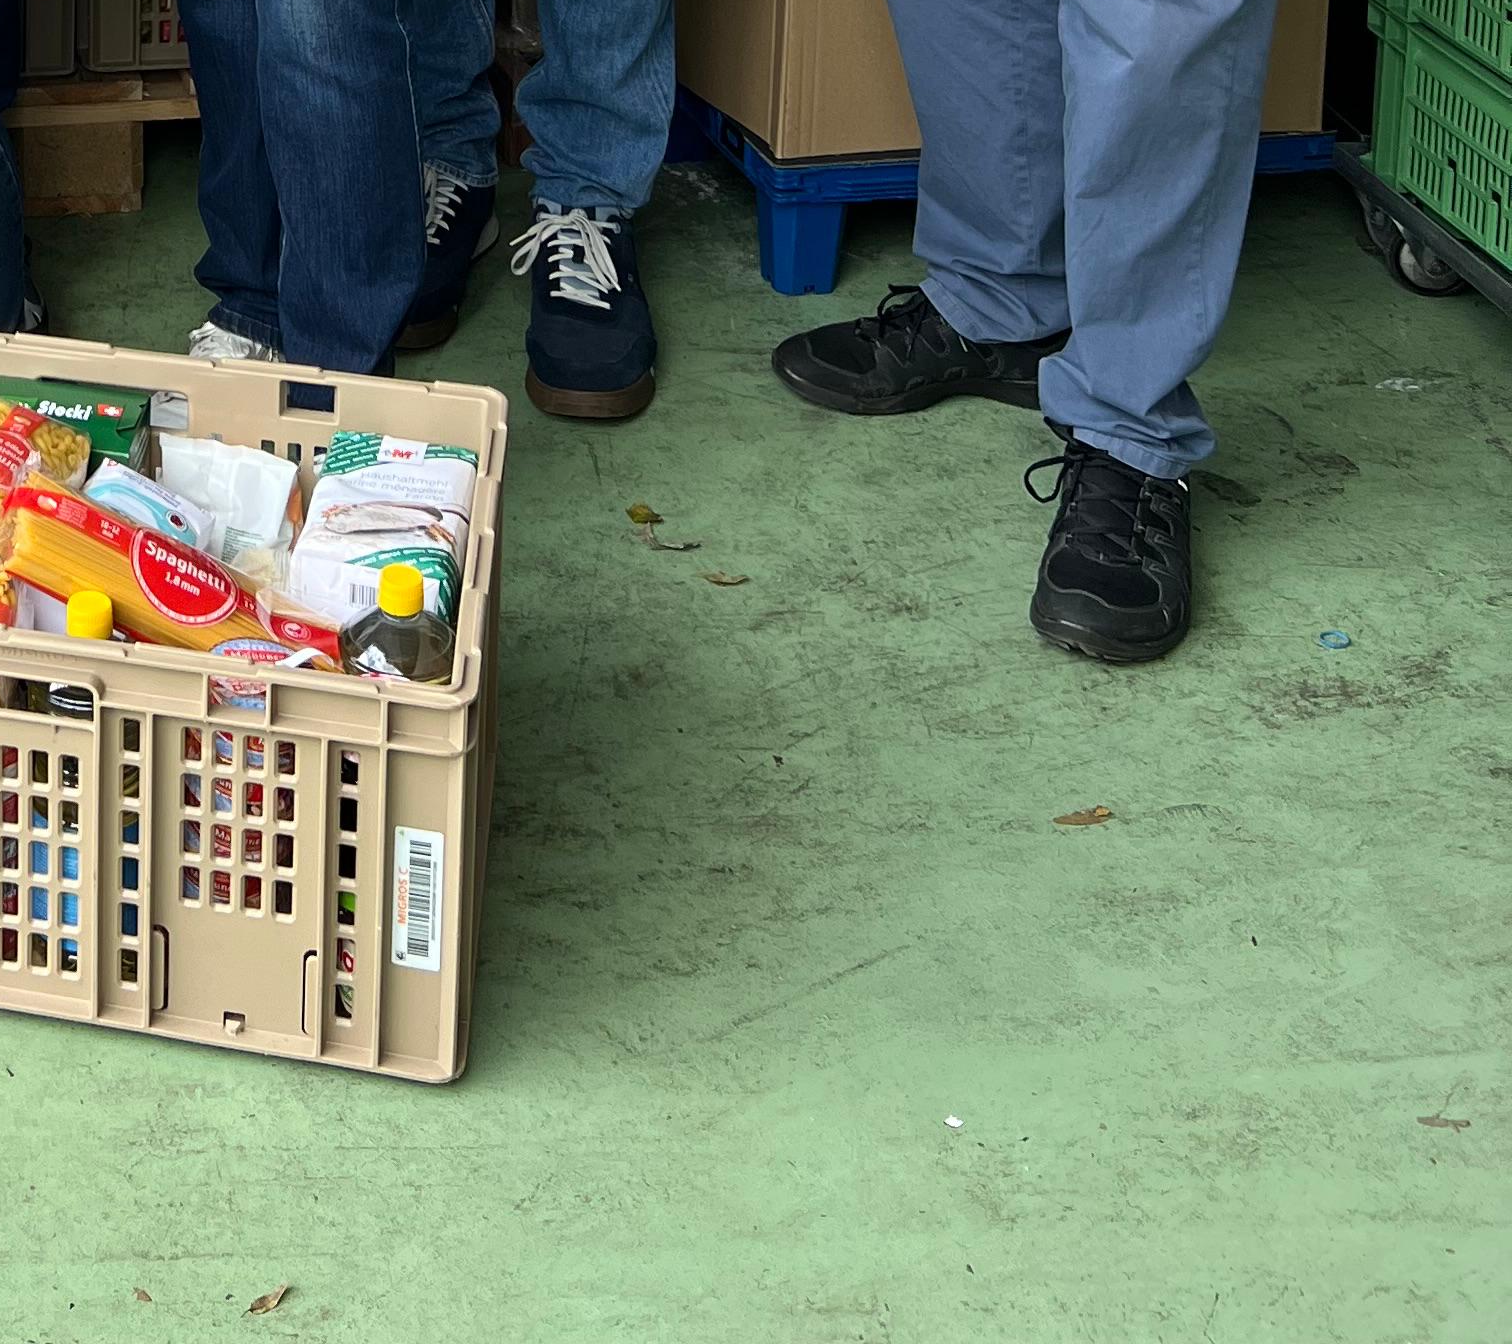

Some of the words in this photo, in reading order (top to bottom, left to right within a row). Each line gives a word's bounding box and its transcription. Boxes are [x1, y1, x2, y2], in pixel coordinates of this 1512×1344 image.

[37, 400, 92, 421] Stocki
[144, 540, 226, 593] Spaghetti
[397, 878, 408, 925] MIGROS
